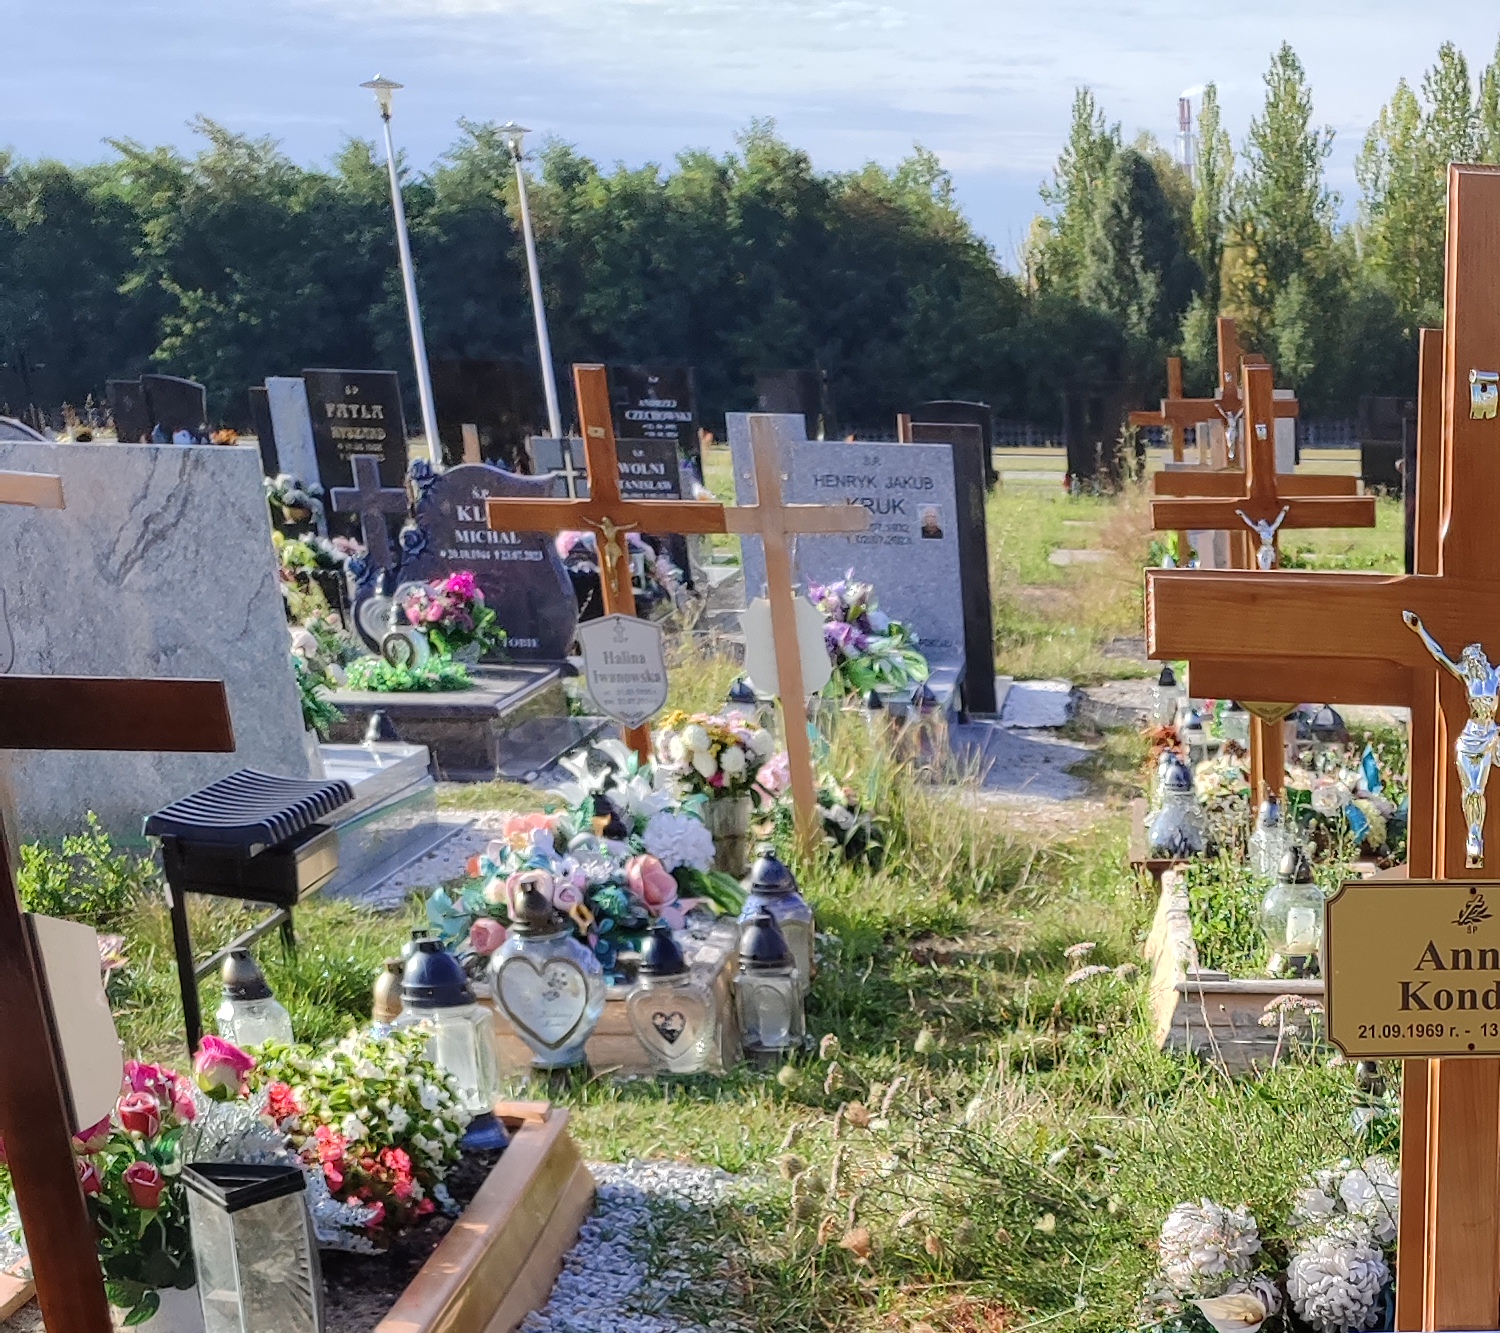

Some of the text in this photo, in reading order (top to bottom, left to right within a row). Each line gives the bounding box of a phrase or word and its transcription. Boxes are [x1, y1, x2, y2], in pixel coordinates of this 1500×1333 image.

[813, 474, 934, 490] HENRYK JAKUB
[602, 650, 646, 665] Halina
[592, 669, 661, 684] Iwanowska
[1357, 1023, 1444, 1039] 21.09.1969
[1449, 1026, 1460, 1038] r.
